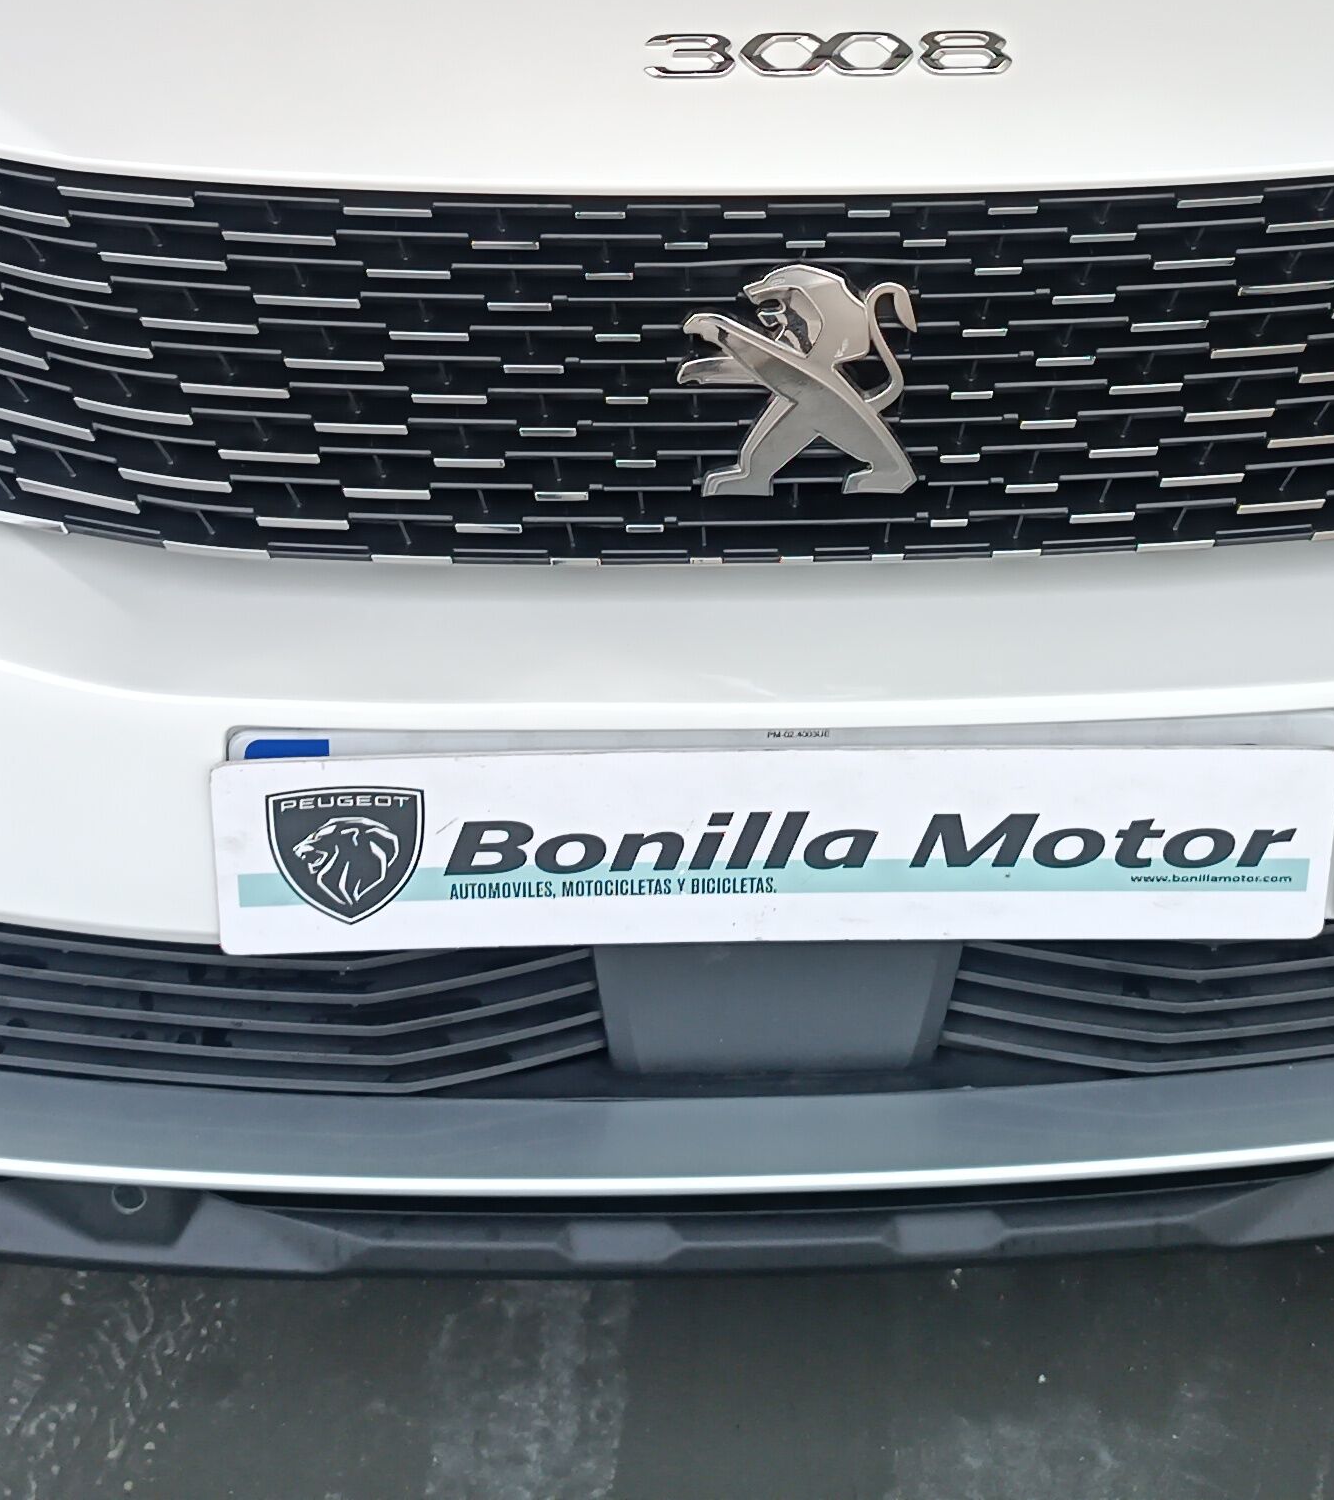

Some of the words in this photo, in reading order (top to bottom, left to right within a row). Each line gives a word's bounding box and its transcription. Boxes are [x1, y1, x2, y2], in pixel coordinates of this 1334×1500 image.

[644, 30, 1013, 79] 3008
[280, 794, 412, 812] PEUGEOT
[444, 811, 879, 876] Bonilla
[909, 812, 1298, 869] Motor
[449, 881, 556, 900] AUTOMOVILES,
[562, 878, 672, 897] MOTOCICLETAS
[677, 877, 686, 893] Y
[691, 876, 778, 895] BICICLETAS.
